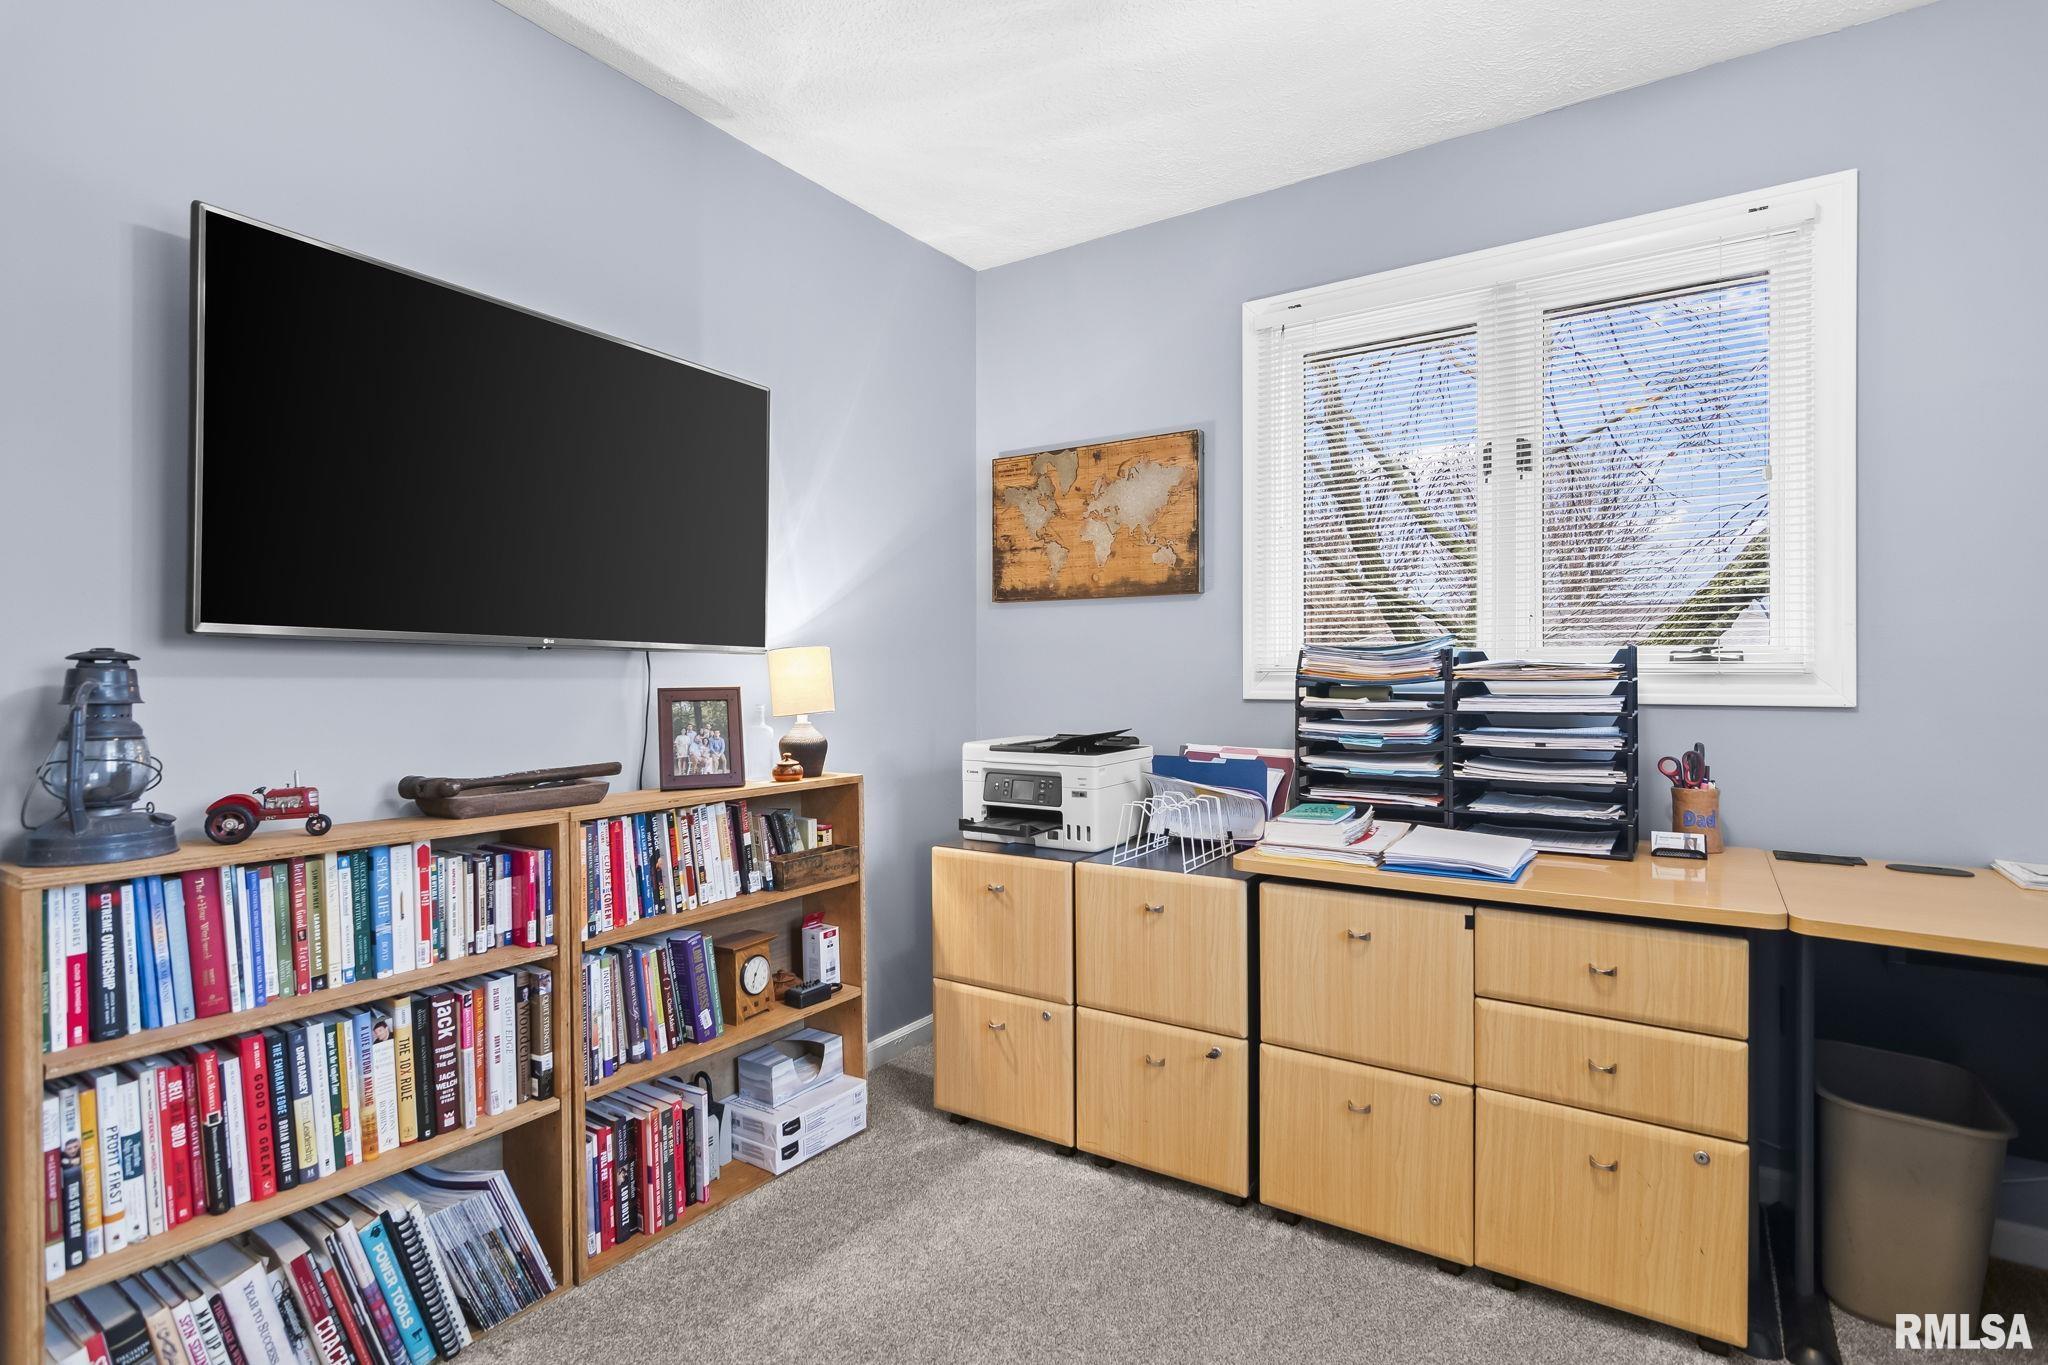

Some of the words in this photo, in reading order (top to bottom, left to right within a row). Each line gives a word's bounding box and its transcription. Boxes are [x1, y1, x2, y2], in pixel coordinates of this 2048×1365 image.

[1683, 810, 1716, 828] Dad
[294, 863, 305, 886] Better
[376, 856, 388, 892] SPEAK
[295, 888, 305, 908] Than
[378, 895, 390, 918] LIFE
[604, 894, 612, 920] COHEN
[72, 892, 81, 947] BOUNDARIES
[100, 893, 112, 934] EXTREME
[194, 878, 205, 892] The
[200, 921, 212, 960] Workweek
[296, 910, 308, 928] Good
[313, 913, 321, 940] LEADERS
[298, 947, 308, 972] Ziglar
[381, 940, 389, 960] BOYD
[692, 945, 704, 963] LAW
[102, 934, 116, 990] OWNERSHIP
[694, 965, 705, 973] OF
[696, 974, 710, 1010] SUCCESS
[504, 997, 512, 1026] SLIGHT
[542, 995, 550, 1016] QUIET
[666, 999, 674, 1015] Circle
[432, 999, 456, 1041] jack
[327, 1031, 336, 1048] Danger
[362, 1032, 370, 1045] LIFE
[519, 1004, 530, 1064] Wooden
[544, 1017, 552, 1054] STRENGTH
[272, 1043, 282, 1057] THE
[296, 1046, 306, 1066] DAVE
[398, 1037, 410, 1056] THE
[362, 1048, 372, 1074] BEYOND
[400, 1058, 412, 1074] 10X
[273, 1059, 286, 1095] EMIGRANT
[298, 1067, 308, 1095] RAMSEY
[330, 1065, 338, 1081] Comfort
[439, 1072, 456, 1081] JACK
[168, 1080, 184, 1103] SELL
[254, 1075, 266, 1108] GOOD
[364, 1076, 374, 1106] AMAZING
[400, 1078, 412, 1101] RULE
[436, 1079, 458, 1091] WELCH
[65, 1094, 75, 1108] TIM
[276, 1097, 287, 1115] EDGE
[66, 1110, 77, 1131] TEBOW
[258, 1115, 268, 1131] TO
[278, 1119, 290, 1143] BRIAN
[106, 1125, 120, 1167] PROFIT
[170, 1123, 186, 1149] SOLD
[190, 1116, 200, 1157] GO-GIVER
[84, 1146, 95, 1163] THE
[260, 1138, 271, 1178] GREAT
[280, 1144, 292, 1173] BUFFINI
[68, 1181, 80, 1199] THIS
[108, 1172, 122, 1206] FIRST
[70, 1209, 80, 1222] THE
[70, 1223, 81, 1238] DAY
[372, 1243, 398, 1289] POWER
[390, 1287, 414, 1329] TOOLS
[214, 1302, 231, 1325] THINK
[243, 1281, 260, 1311] YEAR
[252, 1311, 264, 1324] TO
[260, 1322, 280, 1365] SUCCESS
[178, 1315, 196, 1340] SPIN
[195, 1309, 213, 1335] MAN
[206, 1337, 222, 1351] UP
[222, 1326, 236, 1343] LIKE
